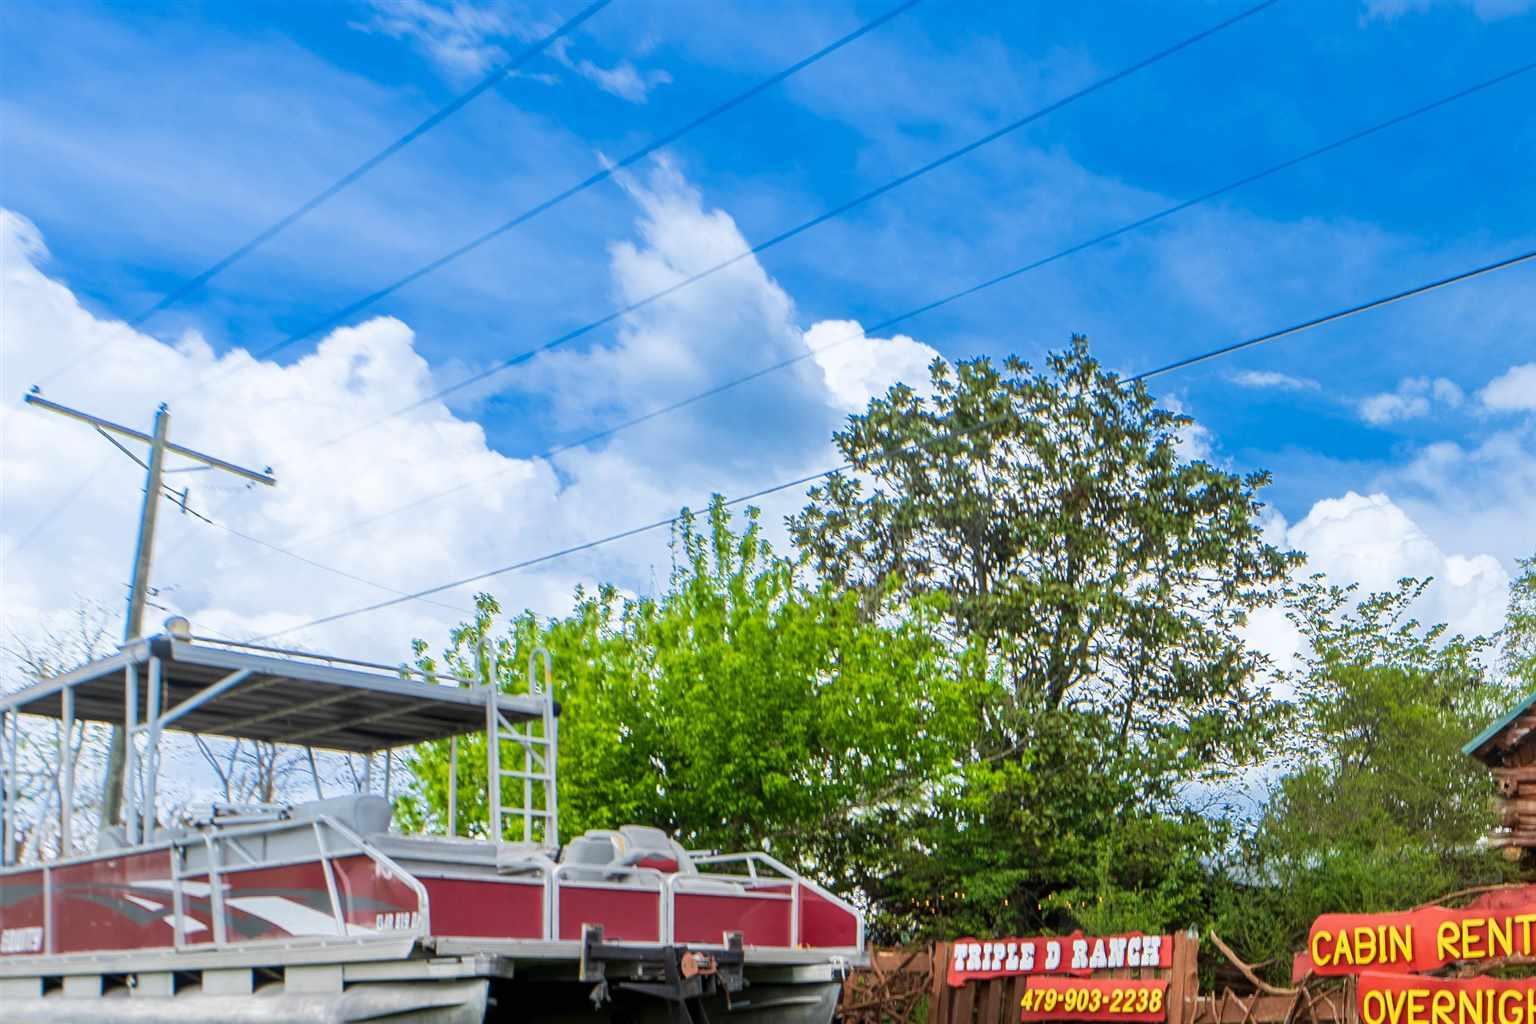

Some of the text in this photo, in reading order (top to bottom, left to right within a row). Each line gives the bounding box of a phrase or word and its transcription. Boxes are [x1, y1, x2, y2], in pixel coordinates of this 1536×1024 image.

[954, 936, 1161, 971] TRIPLE D RANCH
[1311, 924, 1413, 966] CABIN
